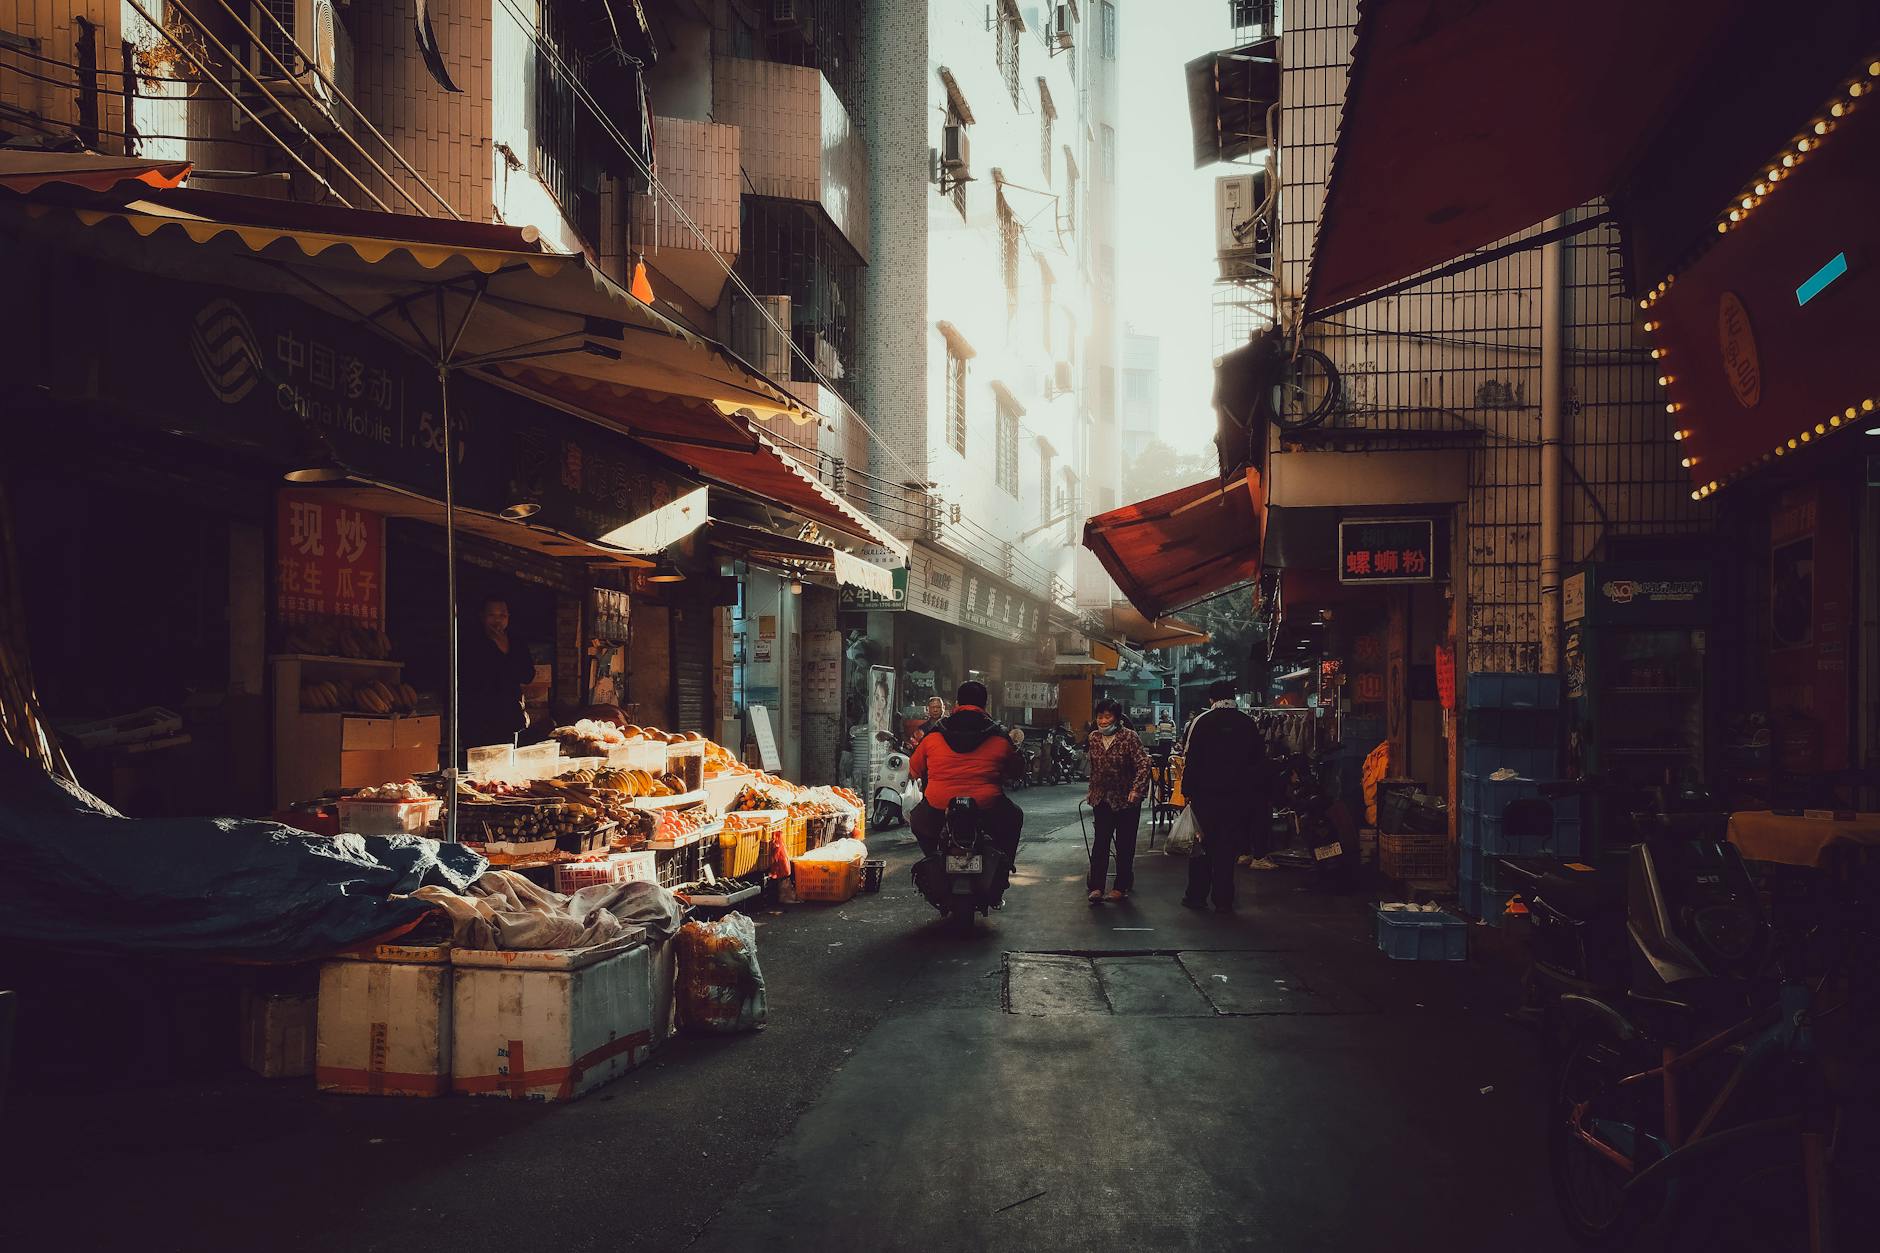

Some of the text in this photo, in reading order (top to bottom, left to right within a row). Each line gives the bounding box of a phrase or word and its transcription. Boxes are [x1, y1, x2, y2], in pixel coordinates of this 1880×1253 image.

[277, 329, 393, 411] 中国移动
[277, 383, 392, 444] China Mobile
[289, 501, 368, 563] 现炒
[1345, 548, 1425, 574] 螺蛳粉
[278, 556, 377, 601] 花生 瓜子
